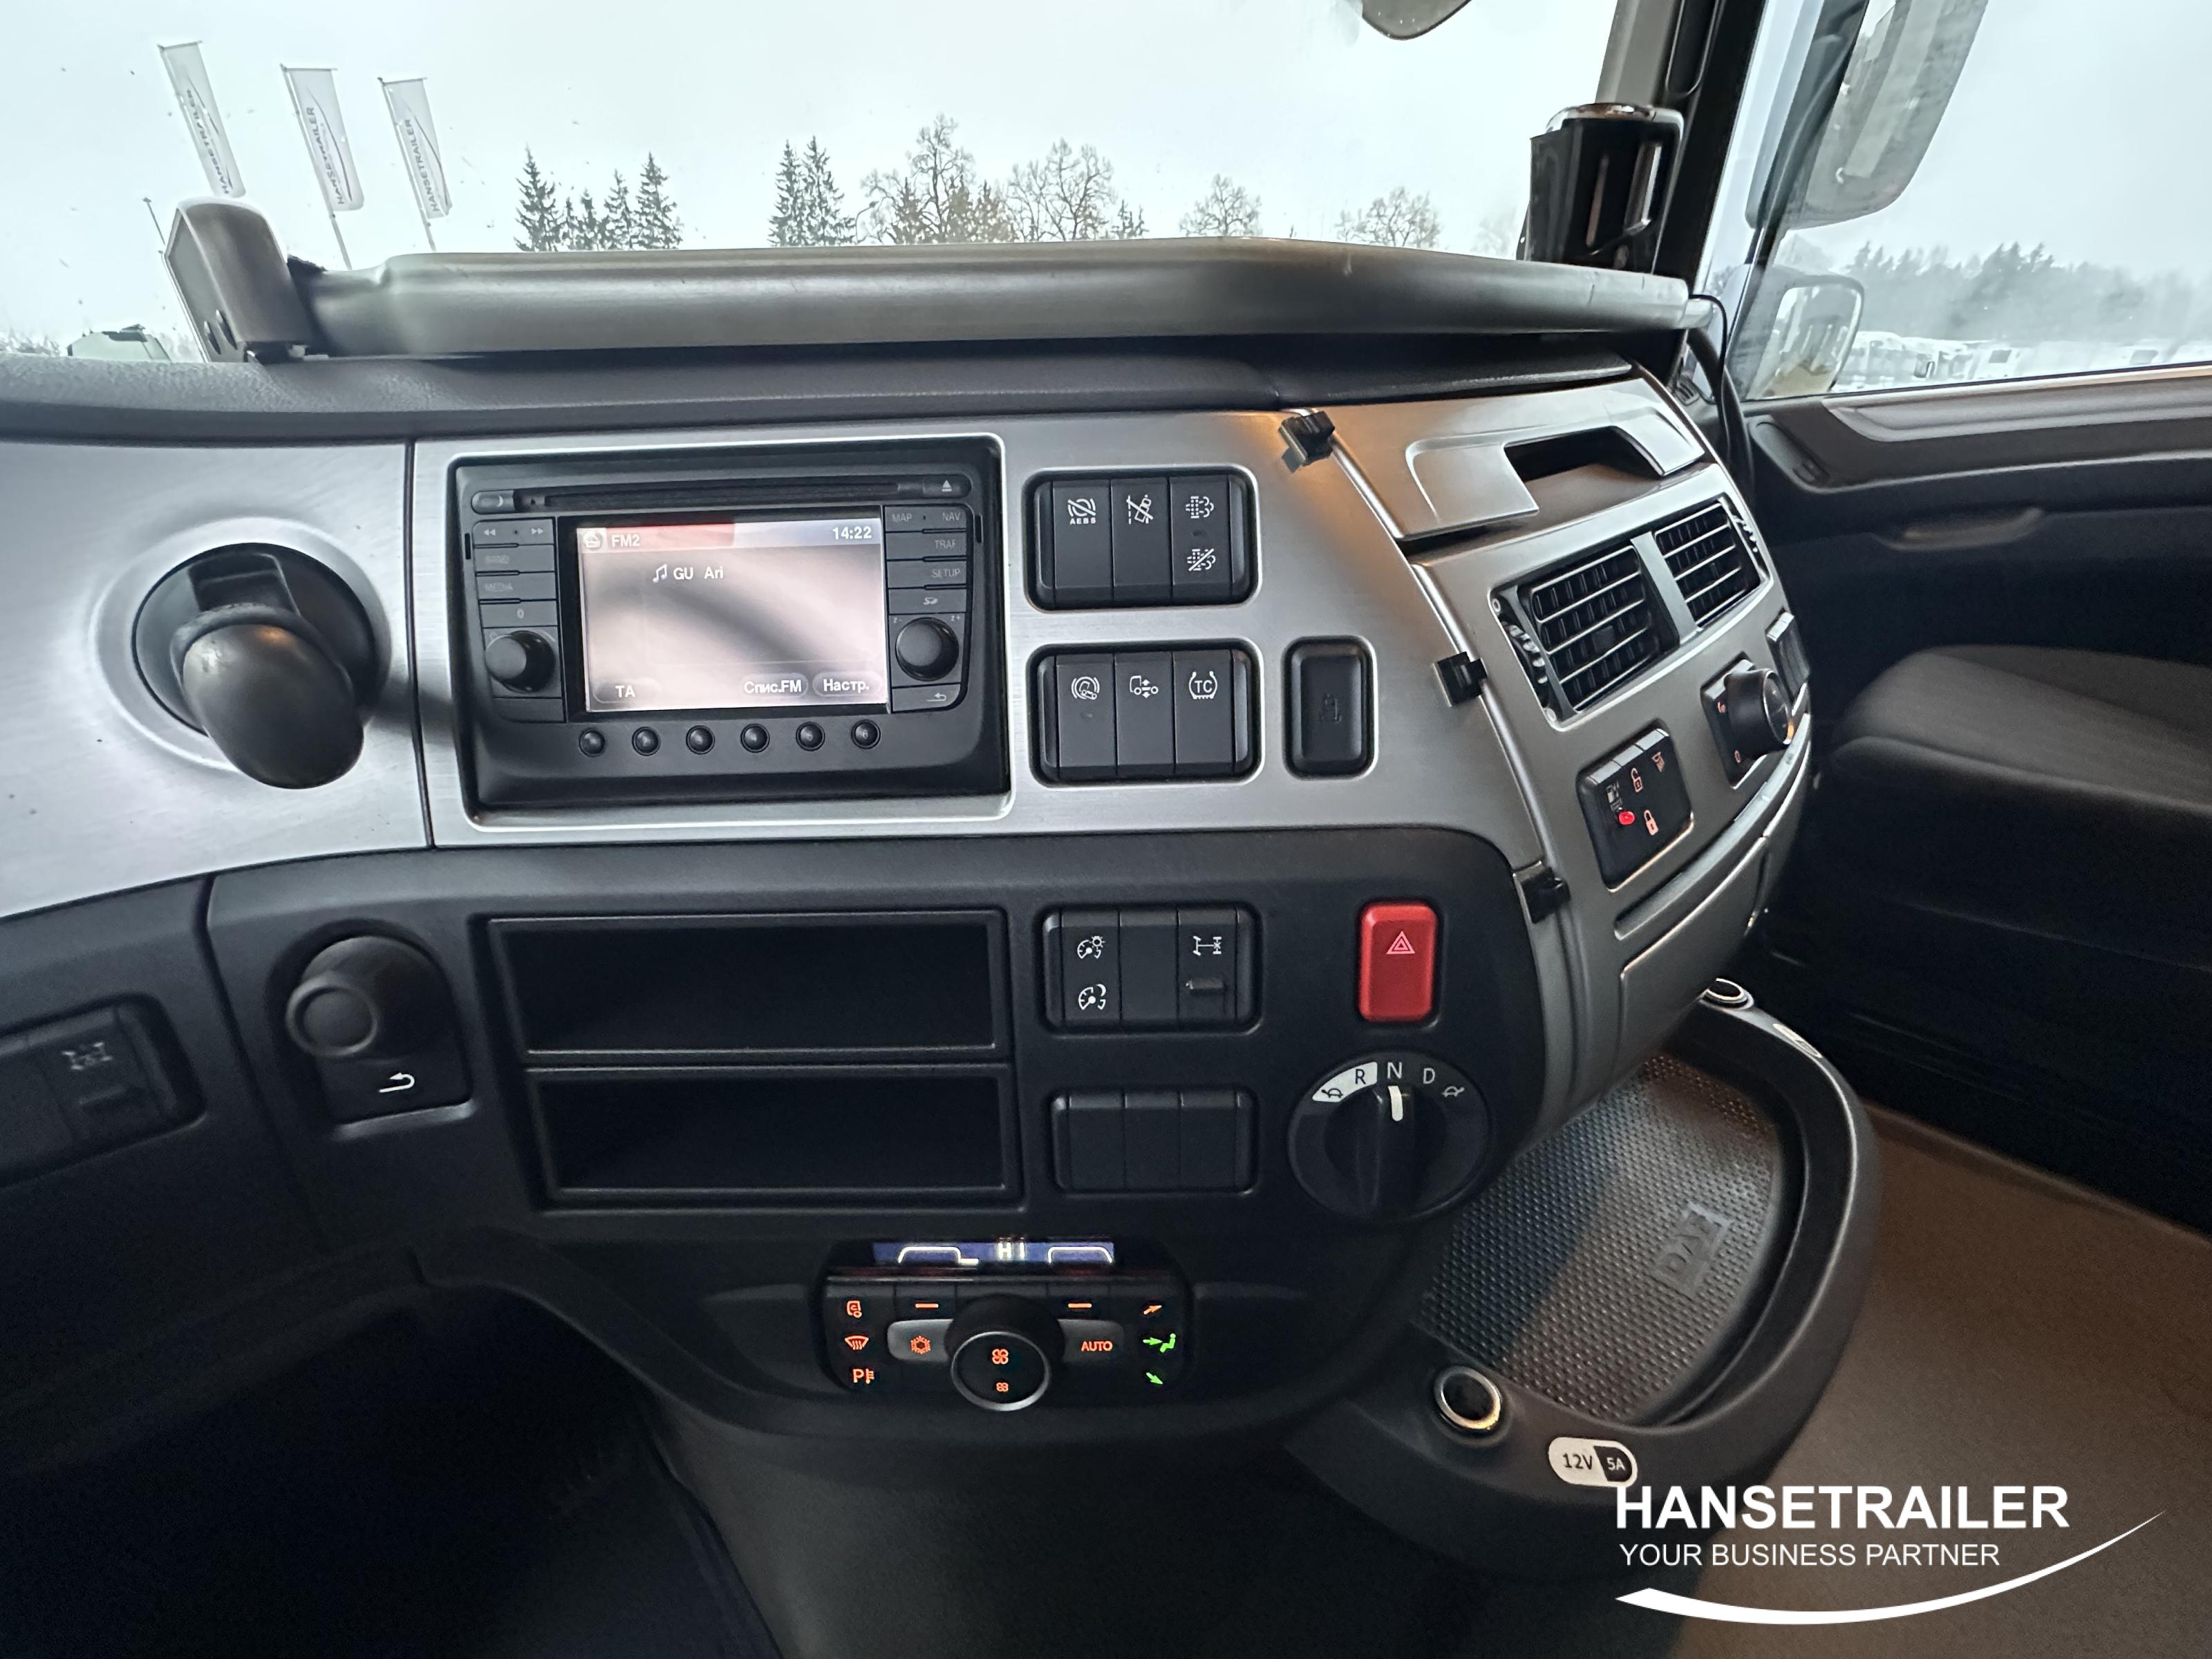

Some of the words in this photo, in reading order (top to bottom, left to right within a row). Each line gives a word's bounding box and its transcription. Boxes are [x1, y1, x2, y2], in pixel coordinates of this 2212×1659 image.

[306, 106, 345, 205] HANSETRAILER
[404, 118, 438, 212] HANSETRAILER
[892, 513, 912, 522] MAP
[942, 512, 961, 521] NAV
[832, 526, 872, 540] 14:22
[611, 534, 641, 547] FM2
[673, 567, 694, 580] GU
[704, 566, 724, 580] Ari
[931, 568, 961, 578] SETUP
[615, 685, 636, 697] TA
[823, 679, 870, 694] Настр.
[1194, 679, 1212, 693] TC
[1355, 1067, 1366, 1085] R
[1387, 1061, 1403, 1078] N
[1423, 1067, 1435, 1084] D
[1081, 1340, 1113, 1352] AUTO
[1562, 1454, 1593, 1471] 12V
[1606, 1456, 1625, 1472] 5A
